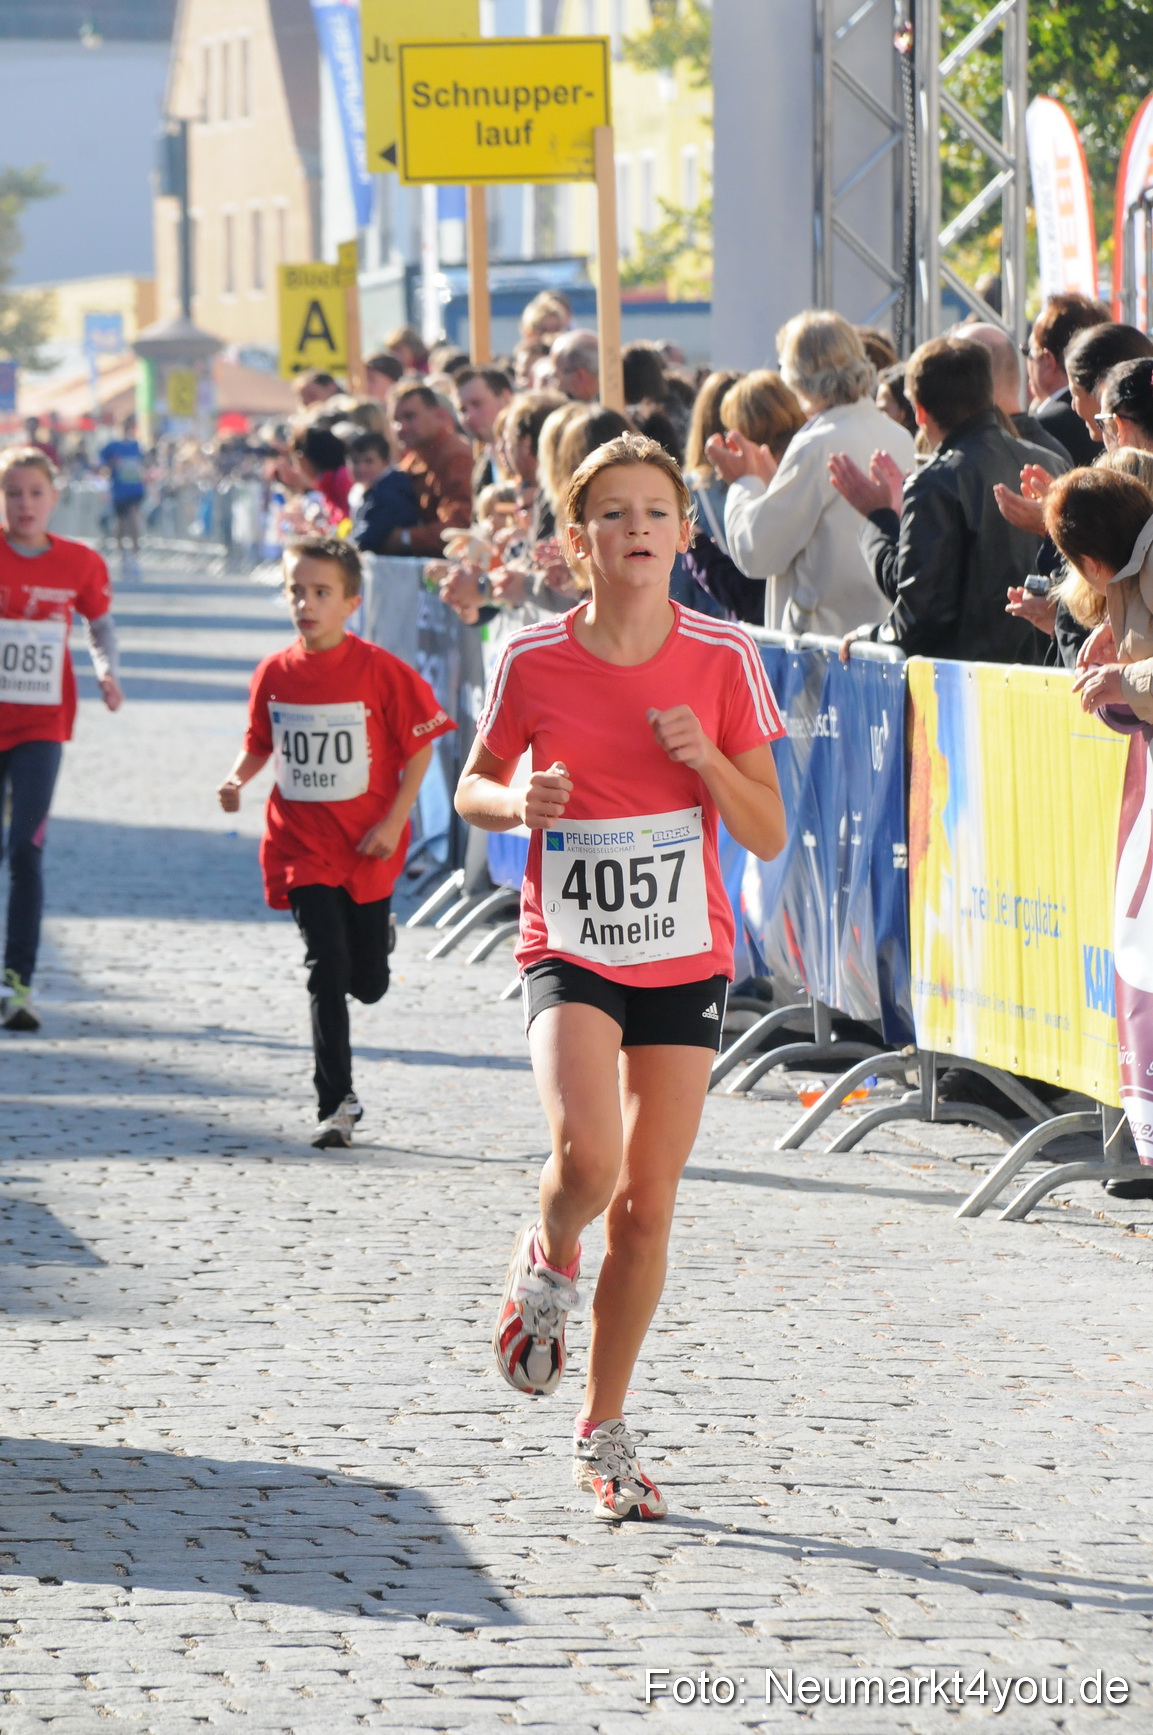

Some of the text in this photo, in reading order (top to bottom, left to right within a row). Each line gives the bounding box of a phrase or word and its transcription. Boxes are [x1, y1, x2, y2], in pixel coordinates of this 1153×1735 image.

[412, 80, 595, 112] Schnupper-
[475, 119, 534, 147] lauf
[297, 299, 336, 353] A
[281, 730, 353, 765] 4070
[292, 768, 337, 788] Peter
[566, 831, 635, 847] PFLEIDERER
[566, 844, 636, 854] AKTIENGESELLSCHAFT
[562, 850, 686, 912] 4057
[579, 913, 675, 945] Amelie
